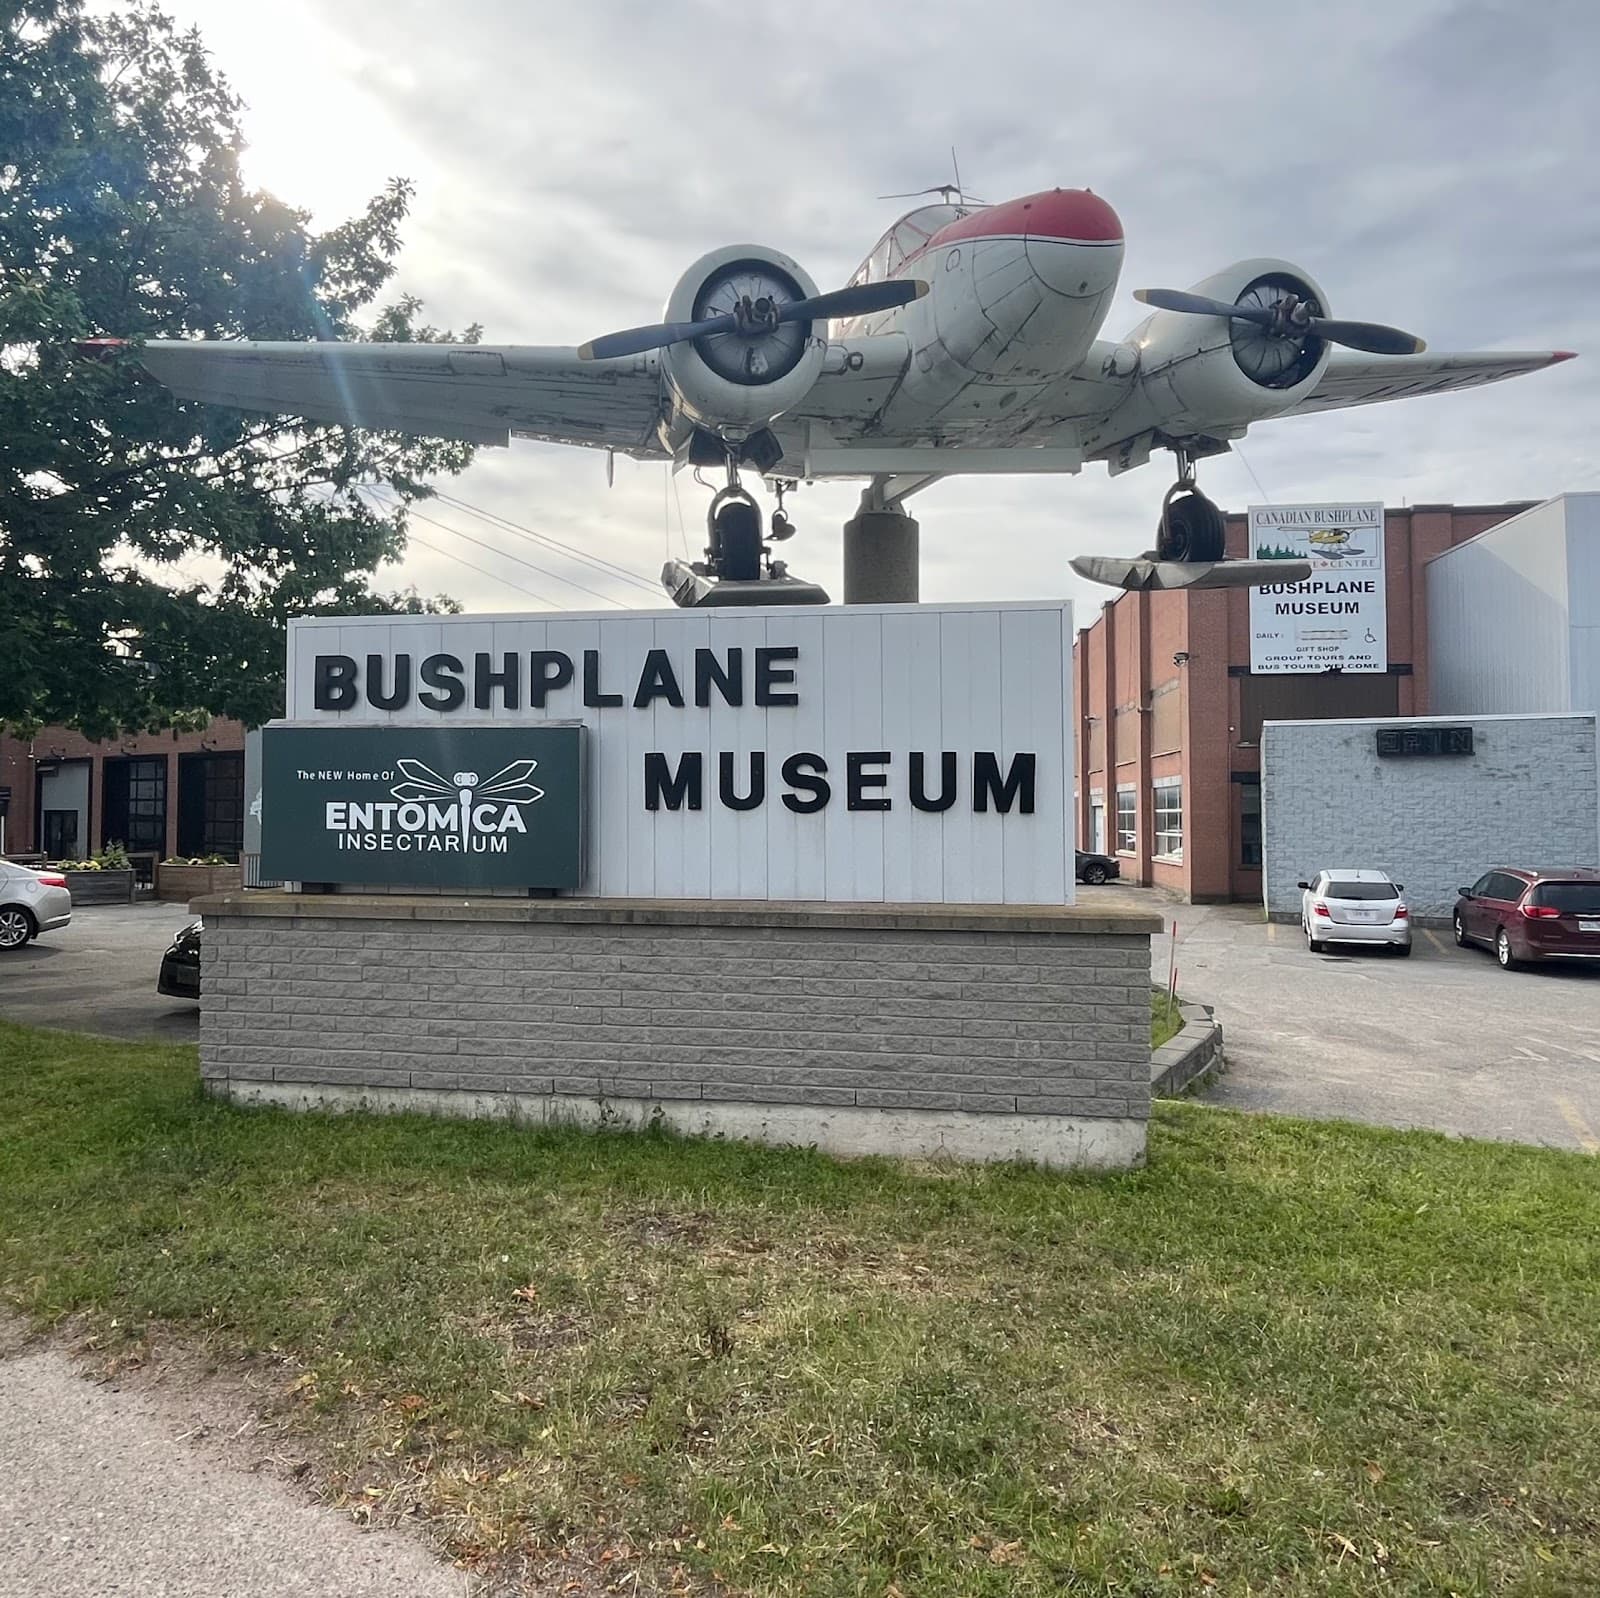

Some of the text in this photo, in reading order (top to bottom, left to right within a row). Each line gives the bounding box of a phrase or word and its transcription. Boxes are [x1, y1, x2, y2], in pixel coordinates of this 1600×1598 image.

[1256, 508, 1377, 525] CANADIAN BUSHPLANE
[1330, 559, 1375, 568] CENTRE
[1259, 580, 1375, 595] BUSHPLANE
[1275, 602, 1360, 615] MUSEUM
[313, 646, 799, 712] BUSHPLANE
[297, 770, 395, 780] The NEW Home Of
[644, 751, 1036, 814] MUSEUM
[325, 801, 527, 833] ENTOMICA
[338, 832, 508, 852] INSECTARIUM
